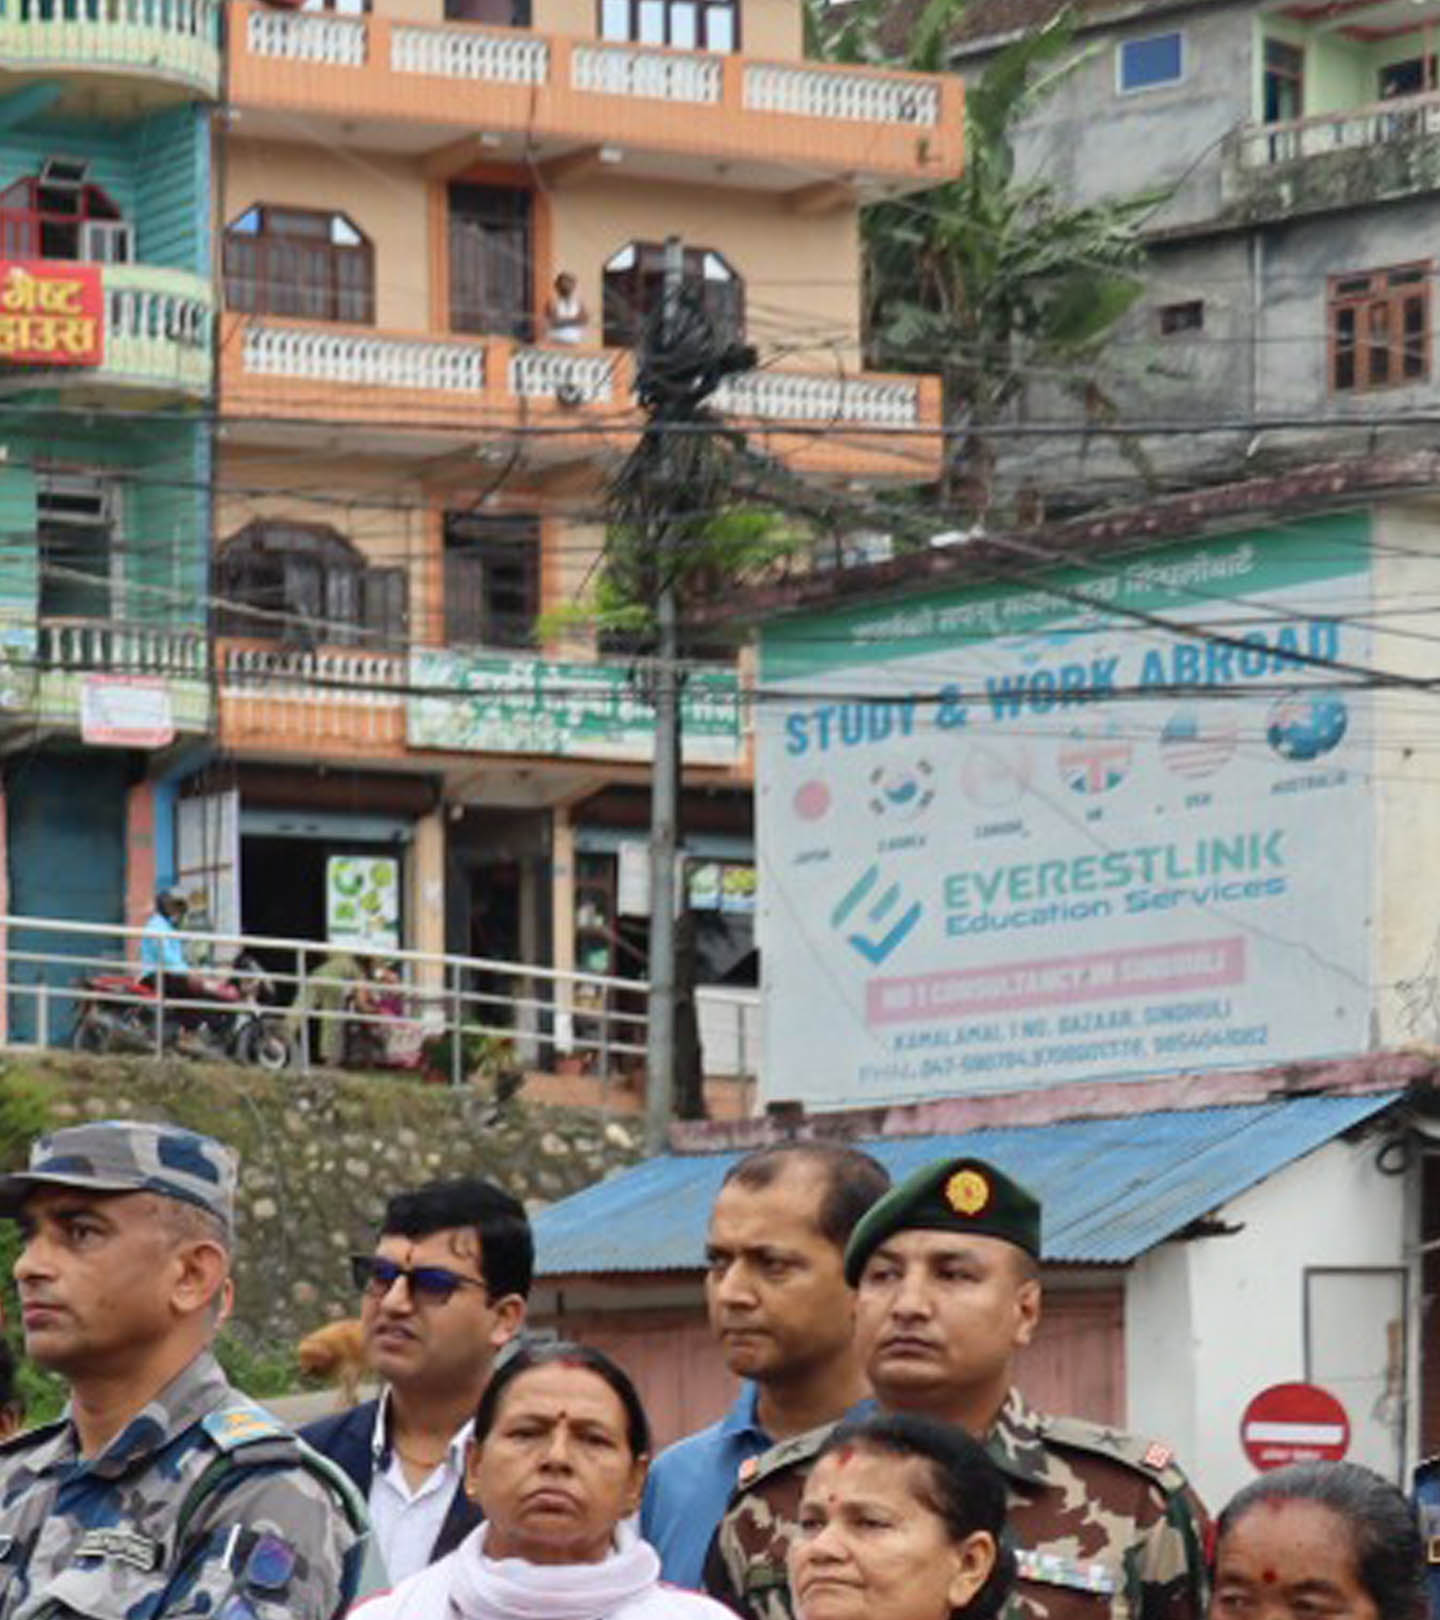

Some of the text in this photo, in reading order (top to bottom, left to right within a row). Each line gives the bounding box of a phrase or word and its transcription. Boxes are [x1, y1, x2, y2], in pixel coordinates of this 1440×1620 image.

[784, 619, 1342, 758] STUDY & WORK ABROAD
[942, 828, 1287, 912] EVERESTLINK
[944, 873, 1287, 938] Education Services
